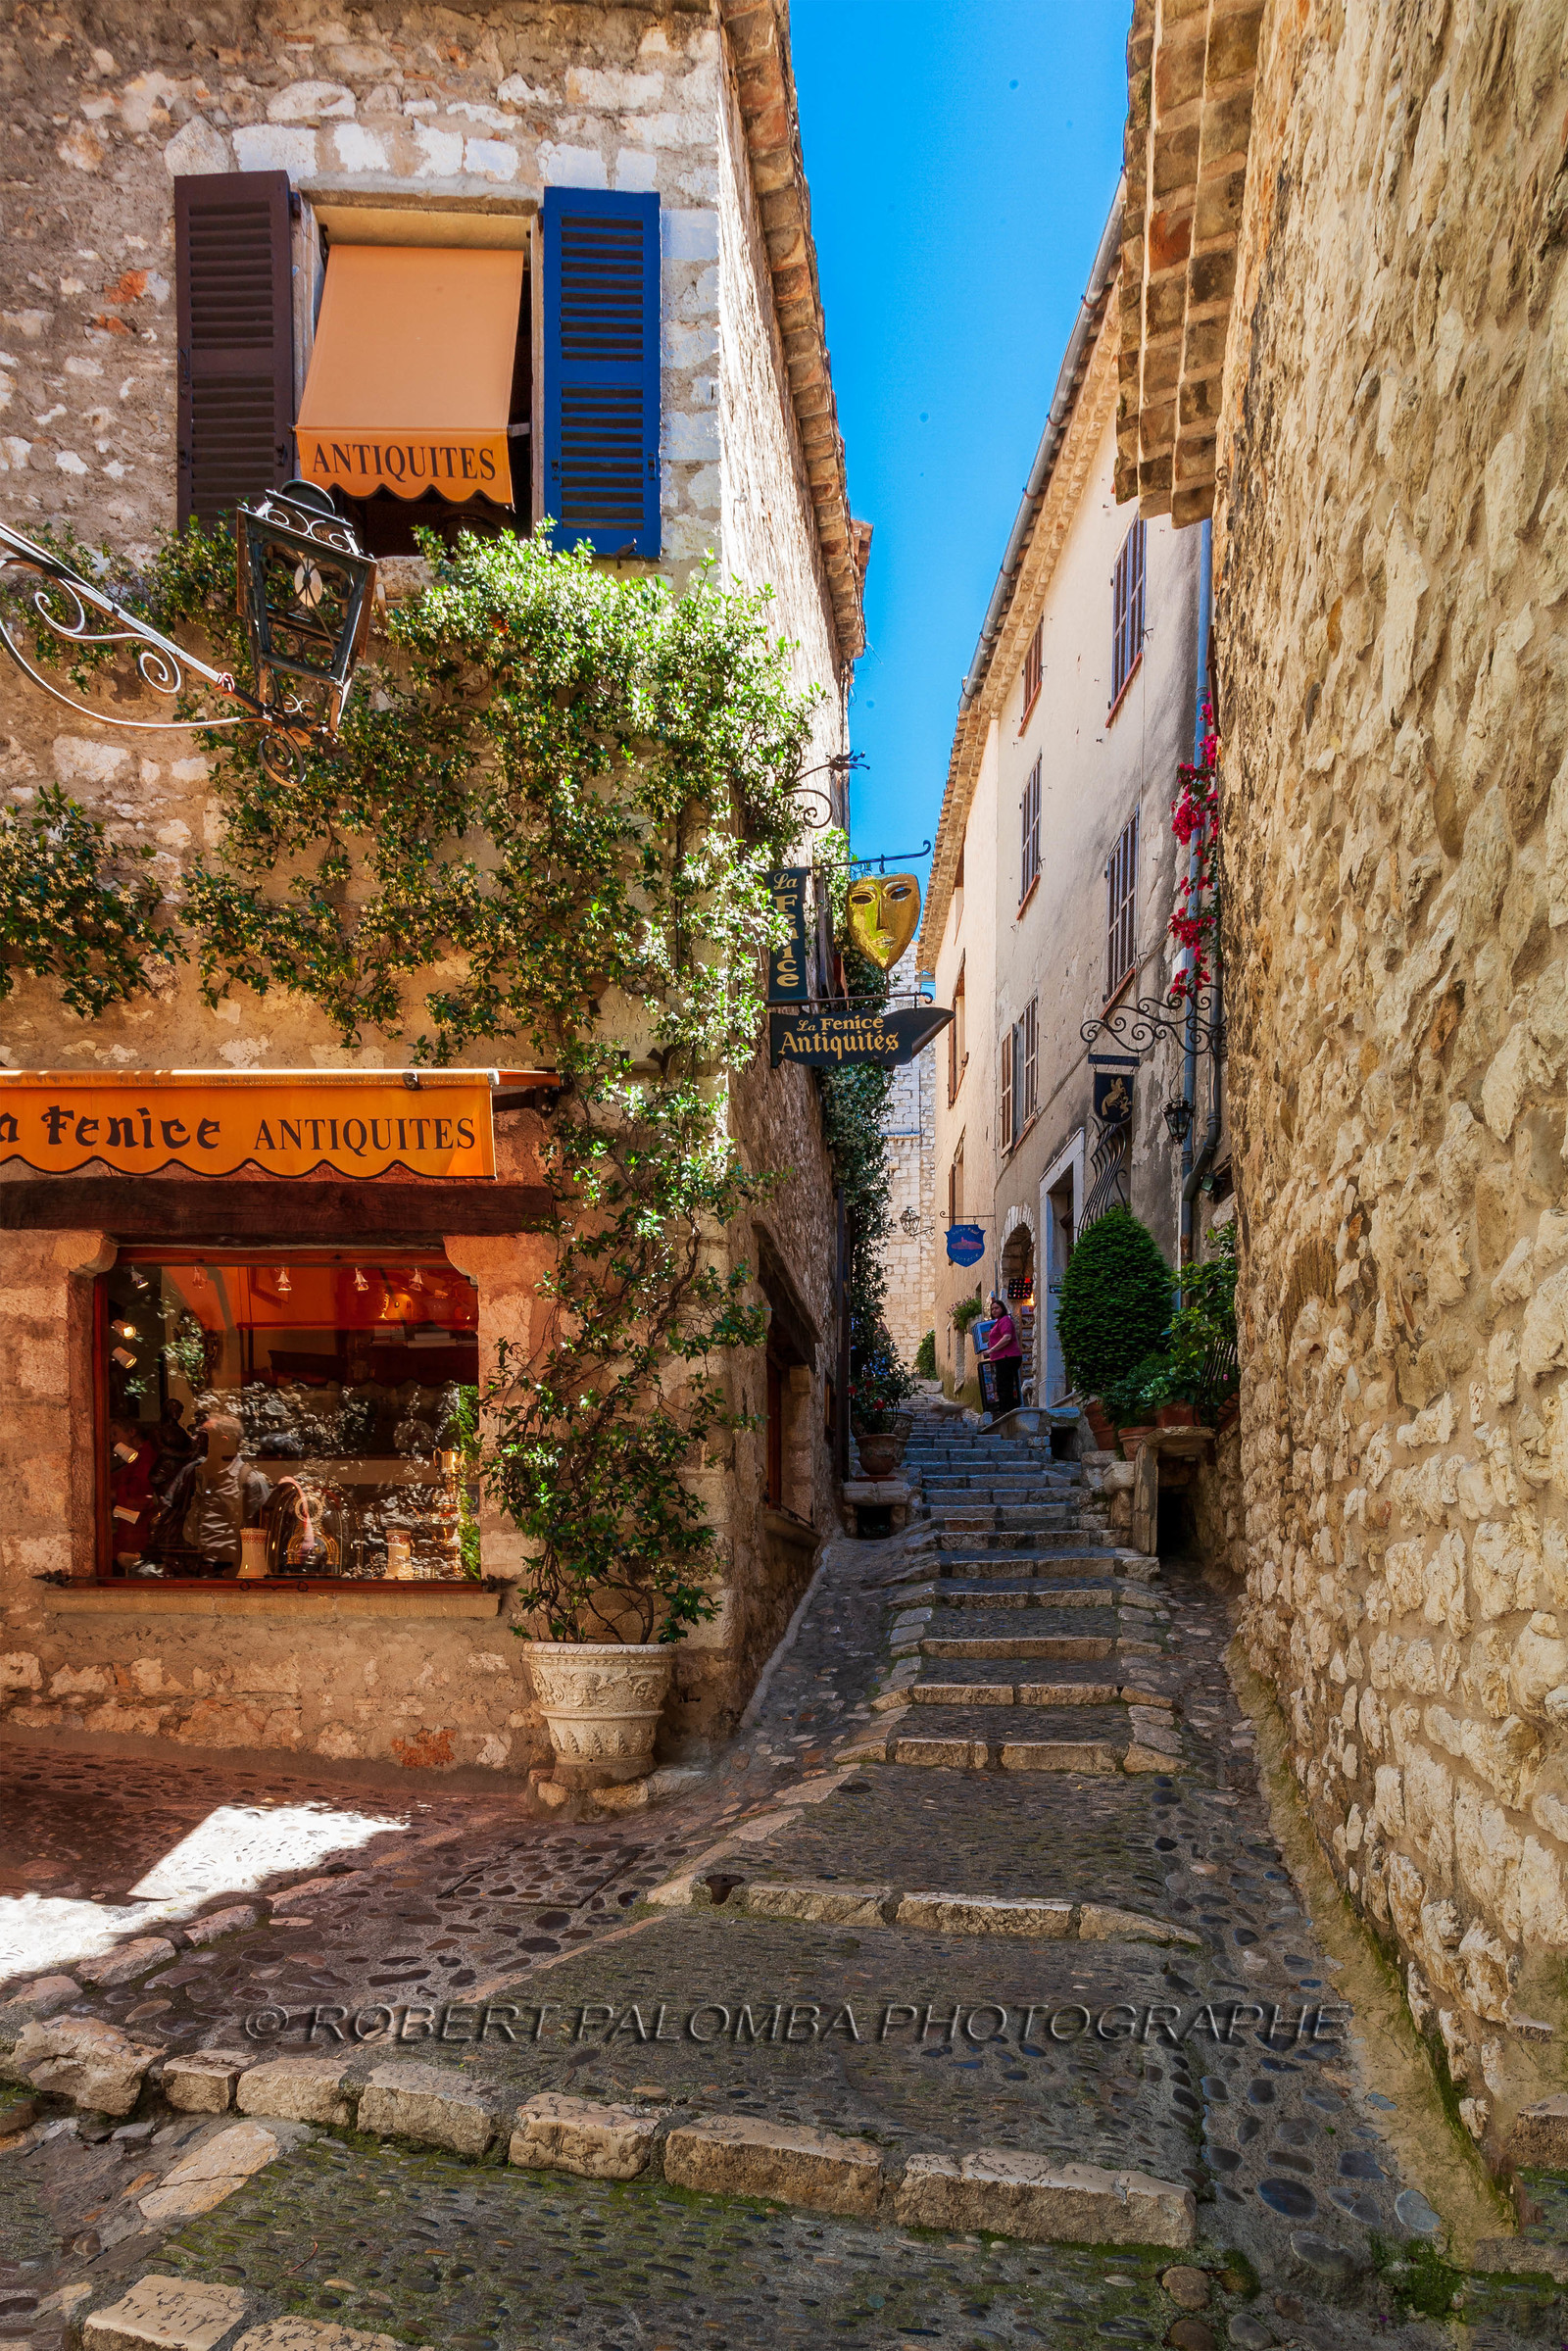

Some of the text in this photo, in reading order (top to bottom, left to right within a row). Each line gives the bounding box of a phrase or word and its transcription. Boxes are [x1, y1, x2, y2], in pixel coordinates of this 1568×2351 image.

[313, 443, 496, 483] ANTIQUITES
[773, 872, 799, 890] La
[797, 1014, 885, 1032] La Fenice
[778, 1030, 899, 1060] Antiquités
[40, 1104, 220, 1150] Fenice
[253, 1117, 475, 1157] ANTIQUITES
